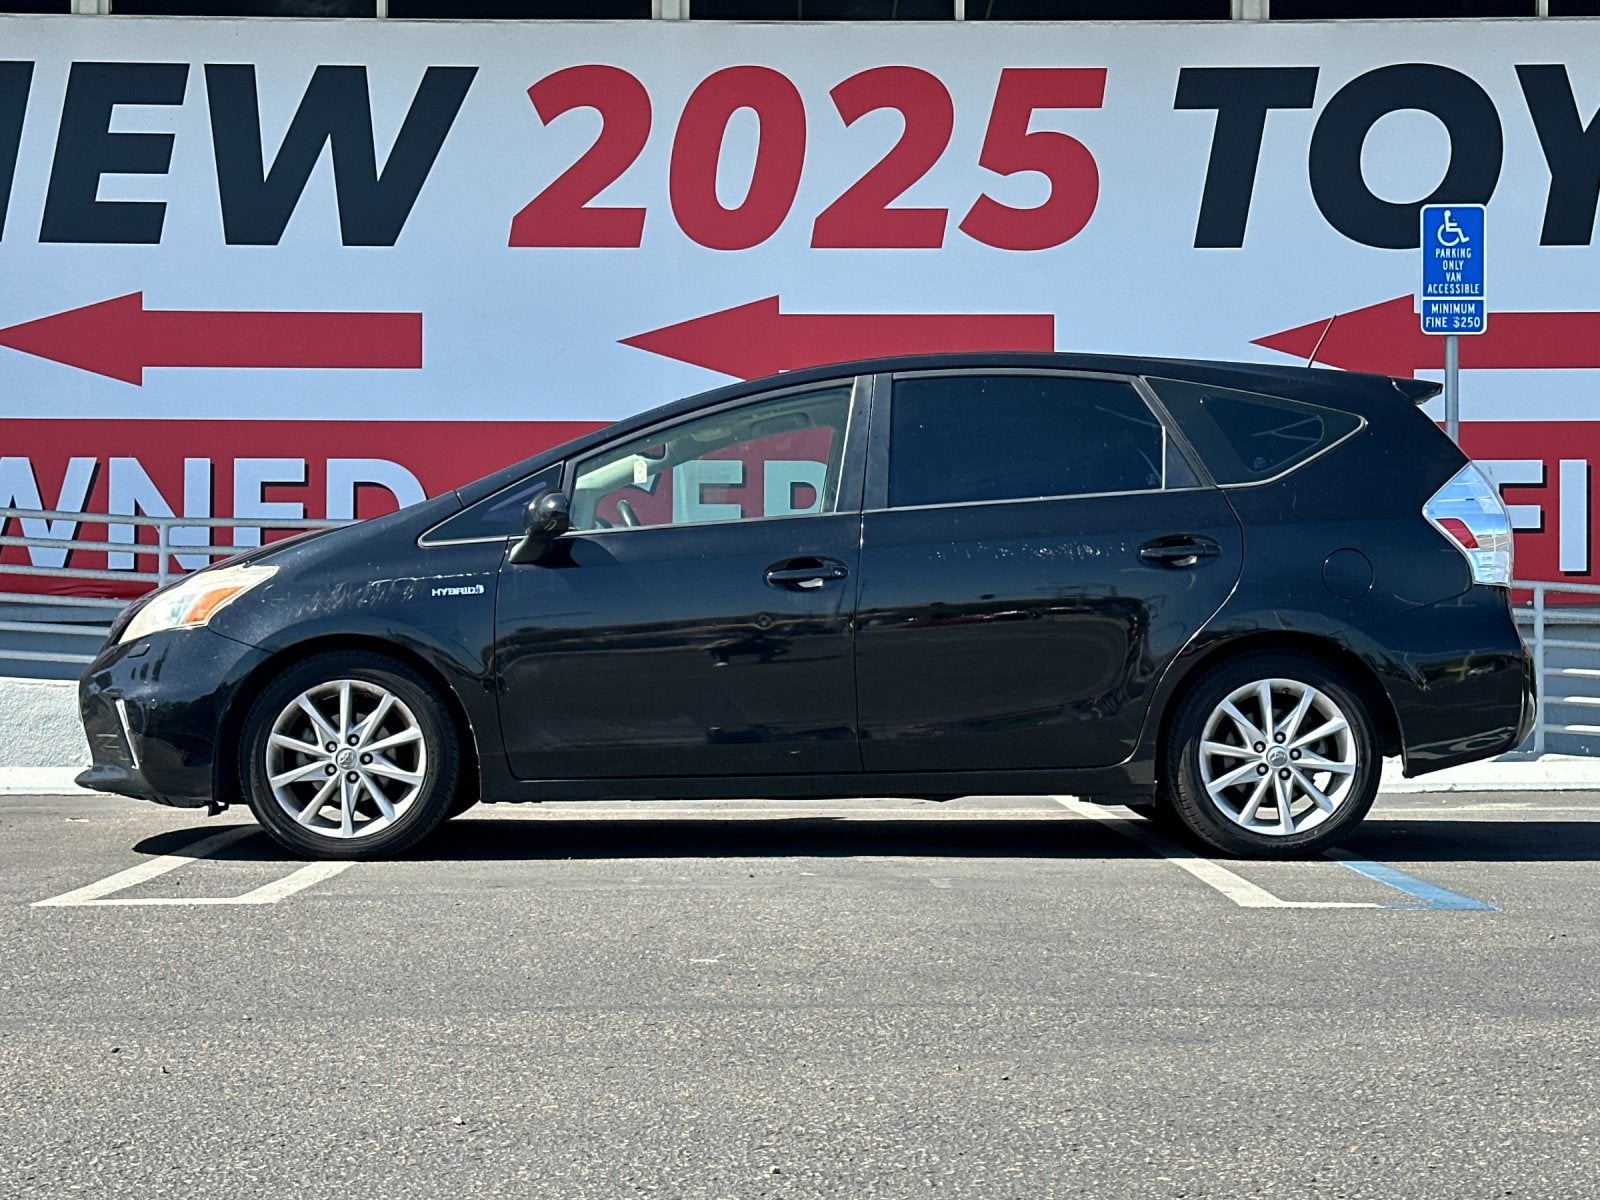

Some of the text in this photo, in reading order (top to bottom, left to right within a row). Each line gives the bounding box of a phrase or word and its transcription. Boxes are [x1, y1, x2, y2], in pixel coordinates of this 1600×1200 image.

[0, 61, 1600, 250] EW 2025 TOY
[1435, 248, 1472, 259] PARKING
[1443, 260, 1464, 271] ONLY
[1445, 272, 1462, 282] VAN
[1427, 284, 1480, 294] ACCESSIBLE
[1431, 303, 1475, 314] MINIMUM
[1425, 316, 1481, 328] FINE $250
[431, 586, 476, 597] HYBRID
